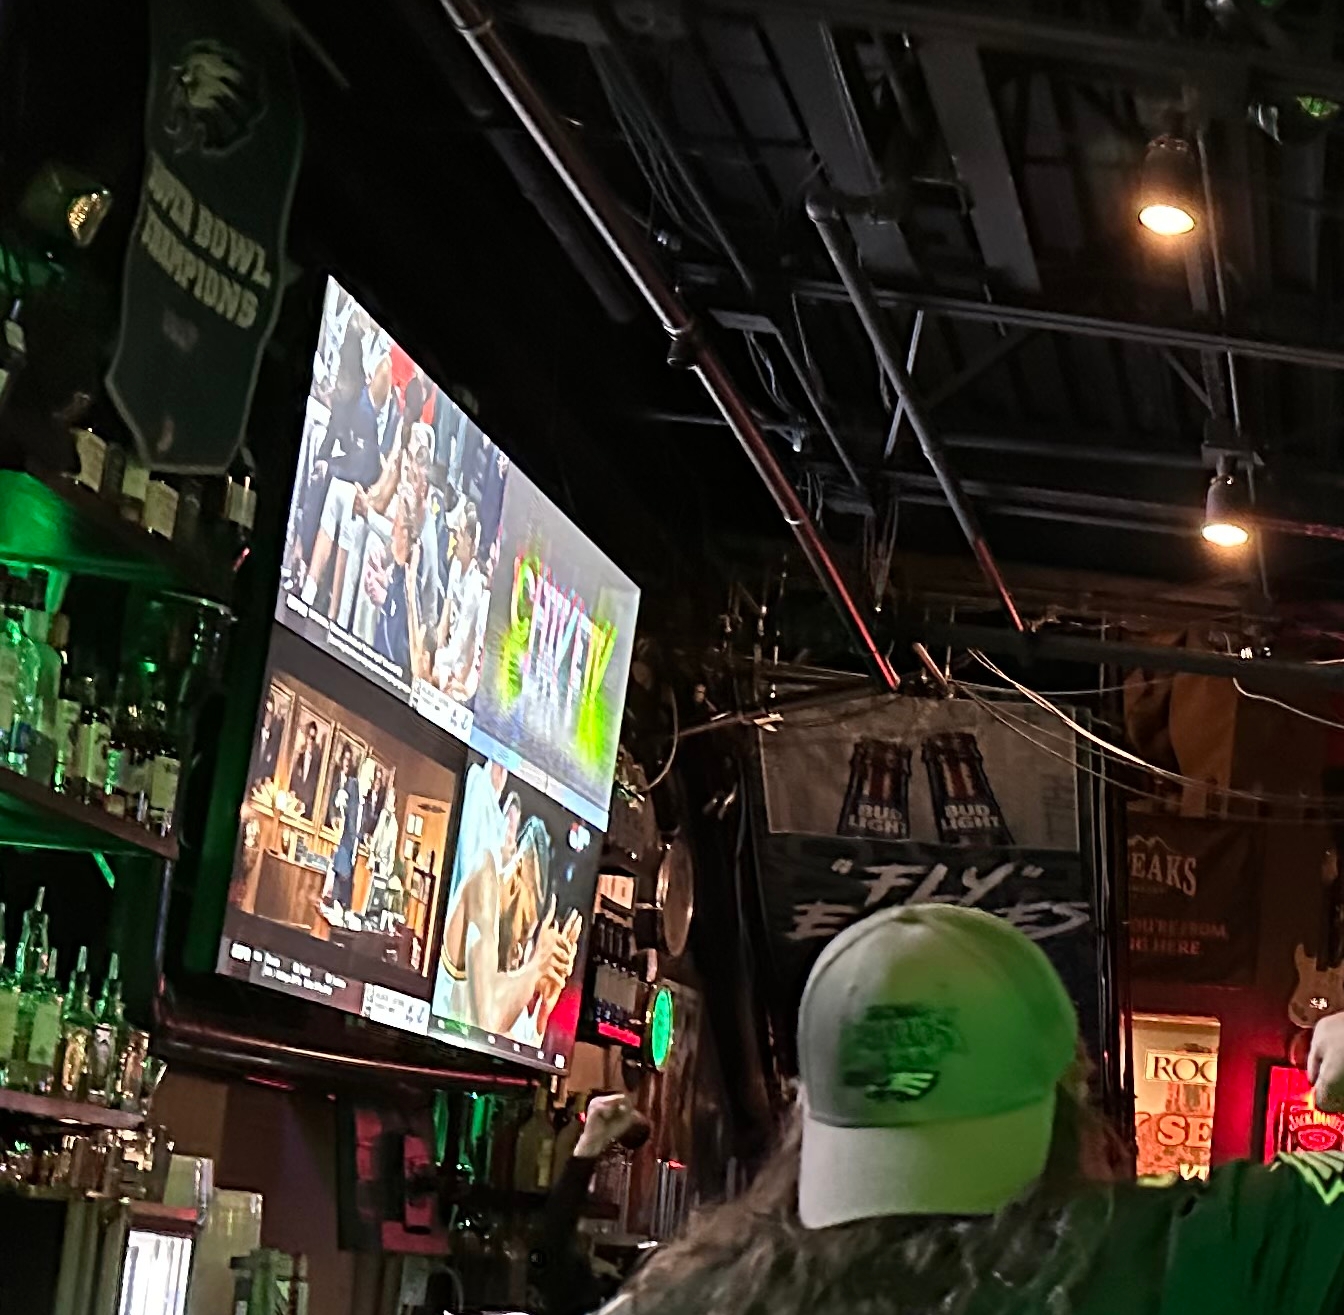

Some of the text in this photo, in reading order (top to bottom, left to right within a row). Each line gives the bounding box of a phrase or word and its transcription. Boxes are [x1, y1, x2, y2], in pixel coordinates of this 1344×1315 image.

[193, 203, 271, 288] BOWL
[849, 804, 906, 834] BUD LIGHT
[941, 805, 999, 830] BUD LIGHT
[1130, 852, 1197, 897] EAKS
